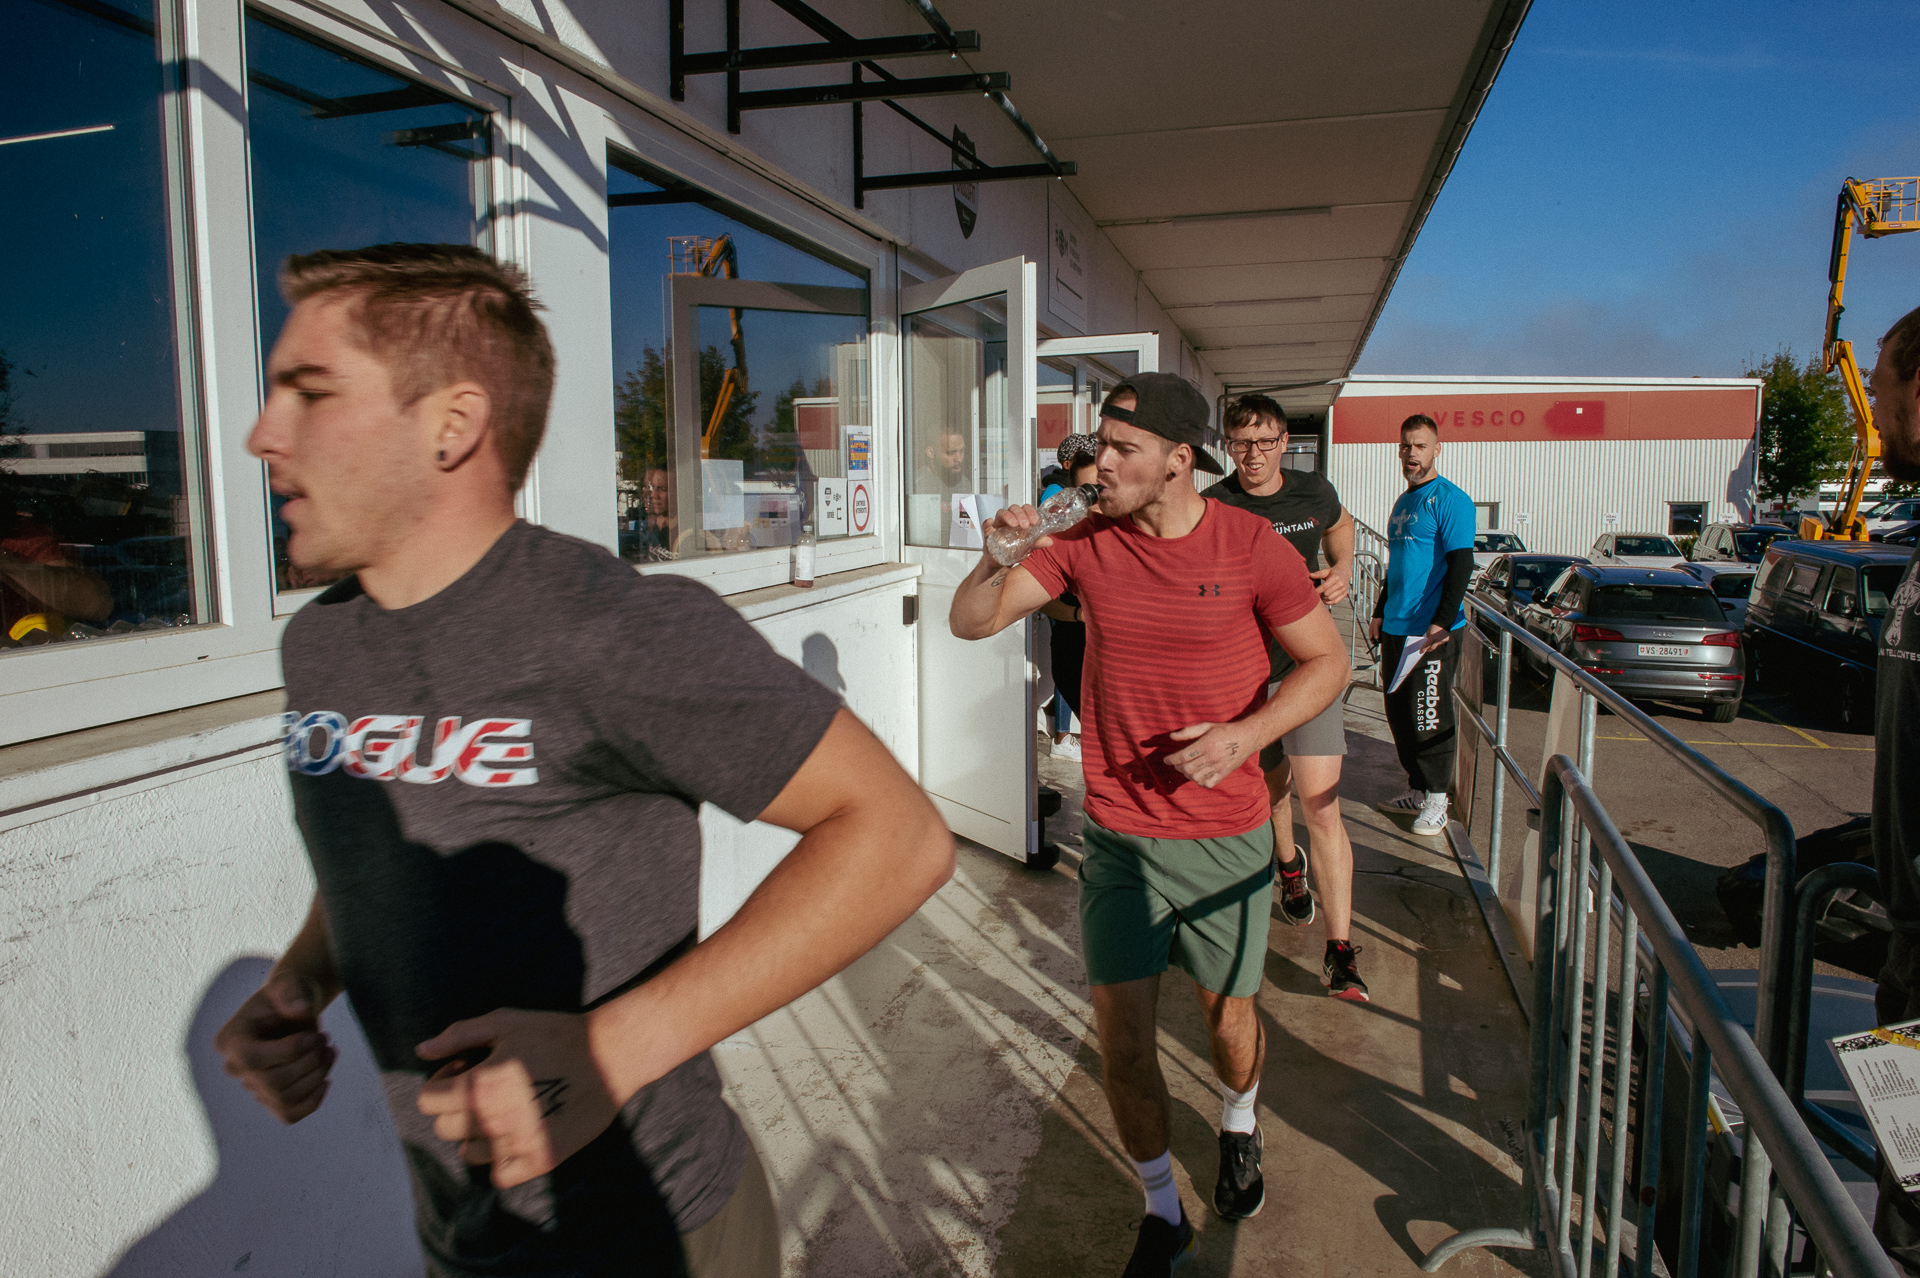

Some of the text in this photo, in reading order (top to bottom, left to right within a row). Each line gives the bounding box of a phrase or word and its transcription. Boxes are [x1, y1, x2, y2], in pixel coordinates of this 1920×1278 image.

[1419, 409, 1525, 427] VESCO
[1275, 521, 1314, 534] UNTAIN
[1423, 659, 1442, 731] Reebok
[1416, 690, 1425, 732] CLASSIC
